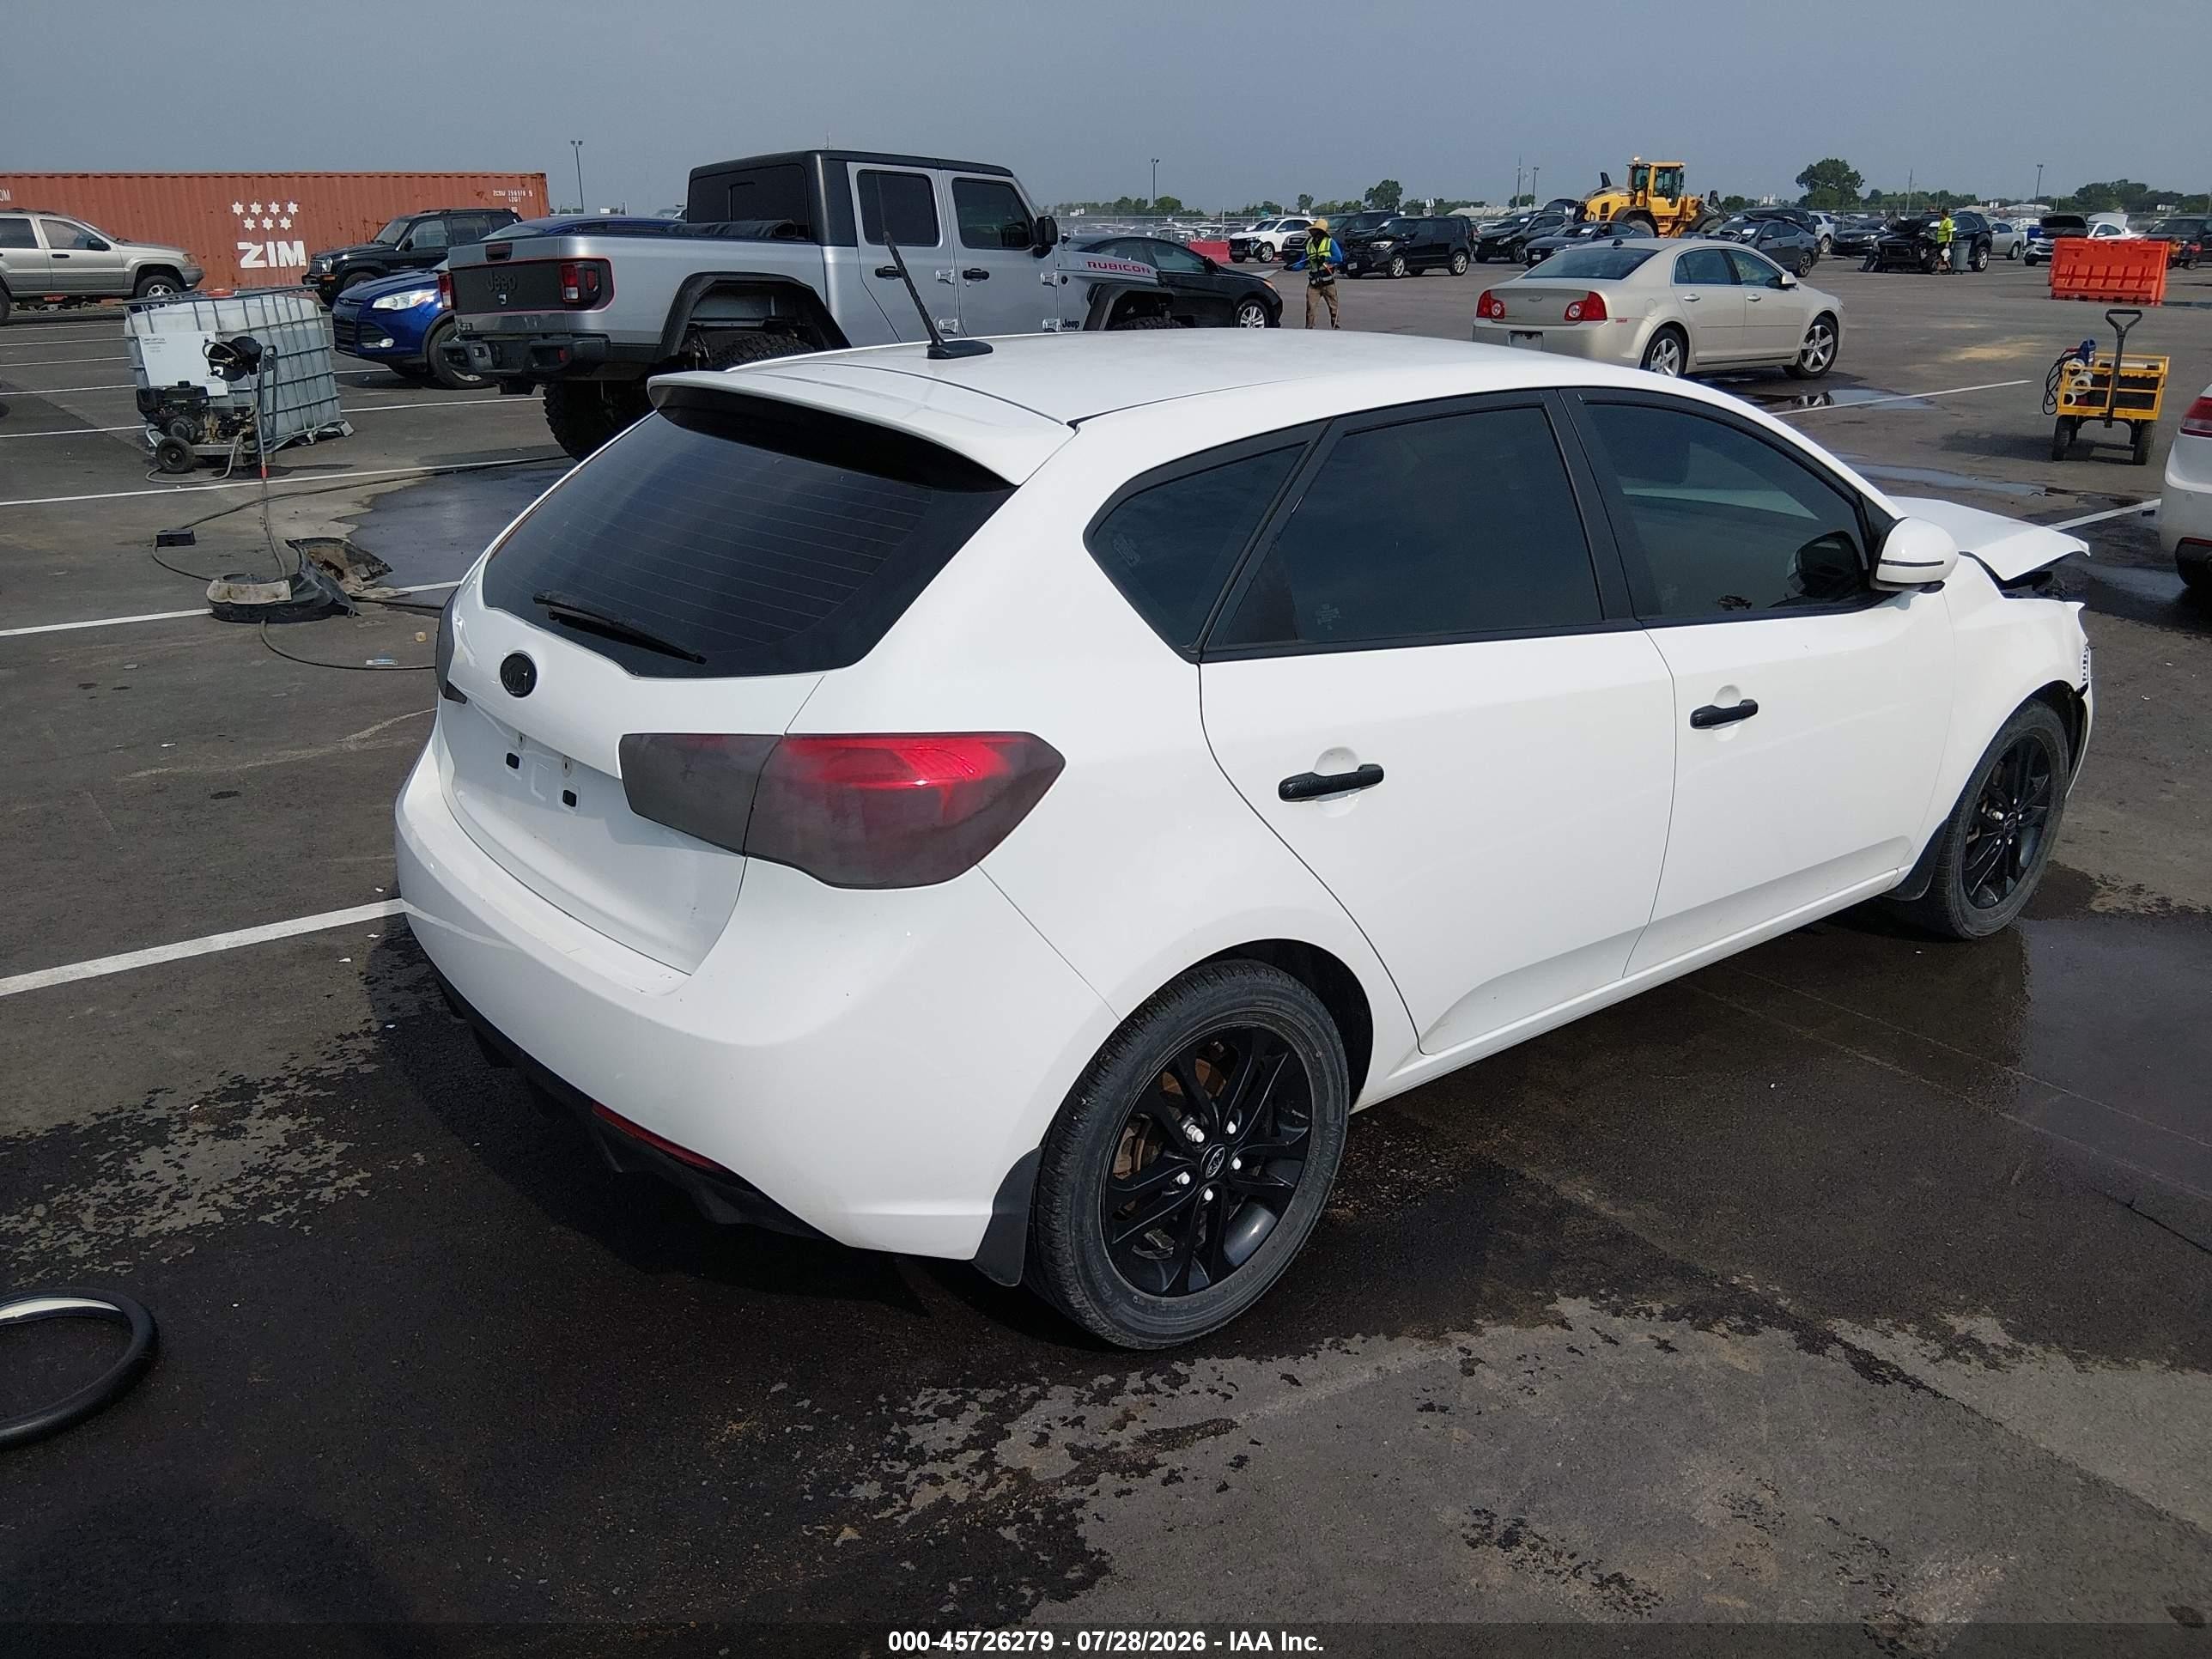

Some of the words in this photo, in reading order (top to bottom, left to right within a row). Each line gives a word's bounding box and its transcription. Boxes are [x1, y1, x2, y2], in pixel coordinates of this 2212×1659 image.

[237, 240, 307, 269] ZIM
[1085, 260, 1151, 275] RUBICON
[487, 270, 519, 292] Jeep
[1061, 319, 1080, 330] Jeep
